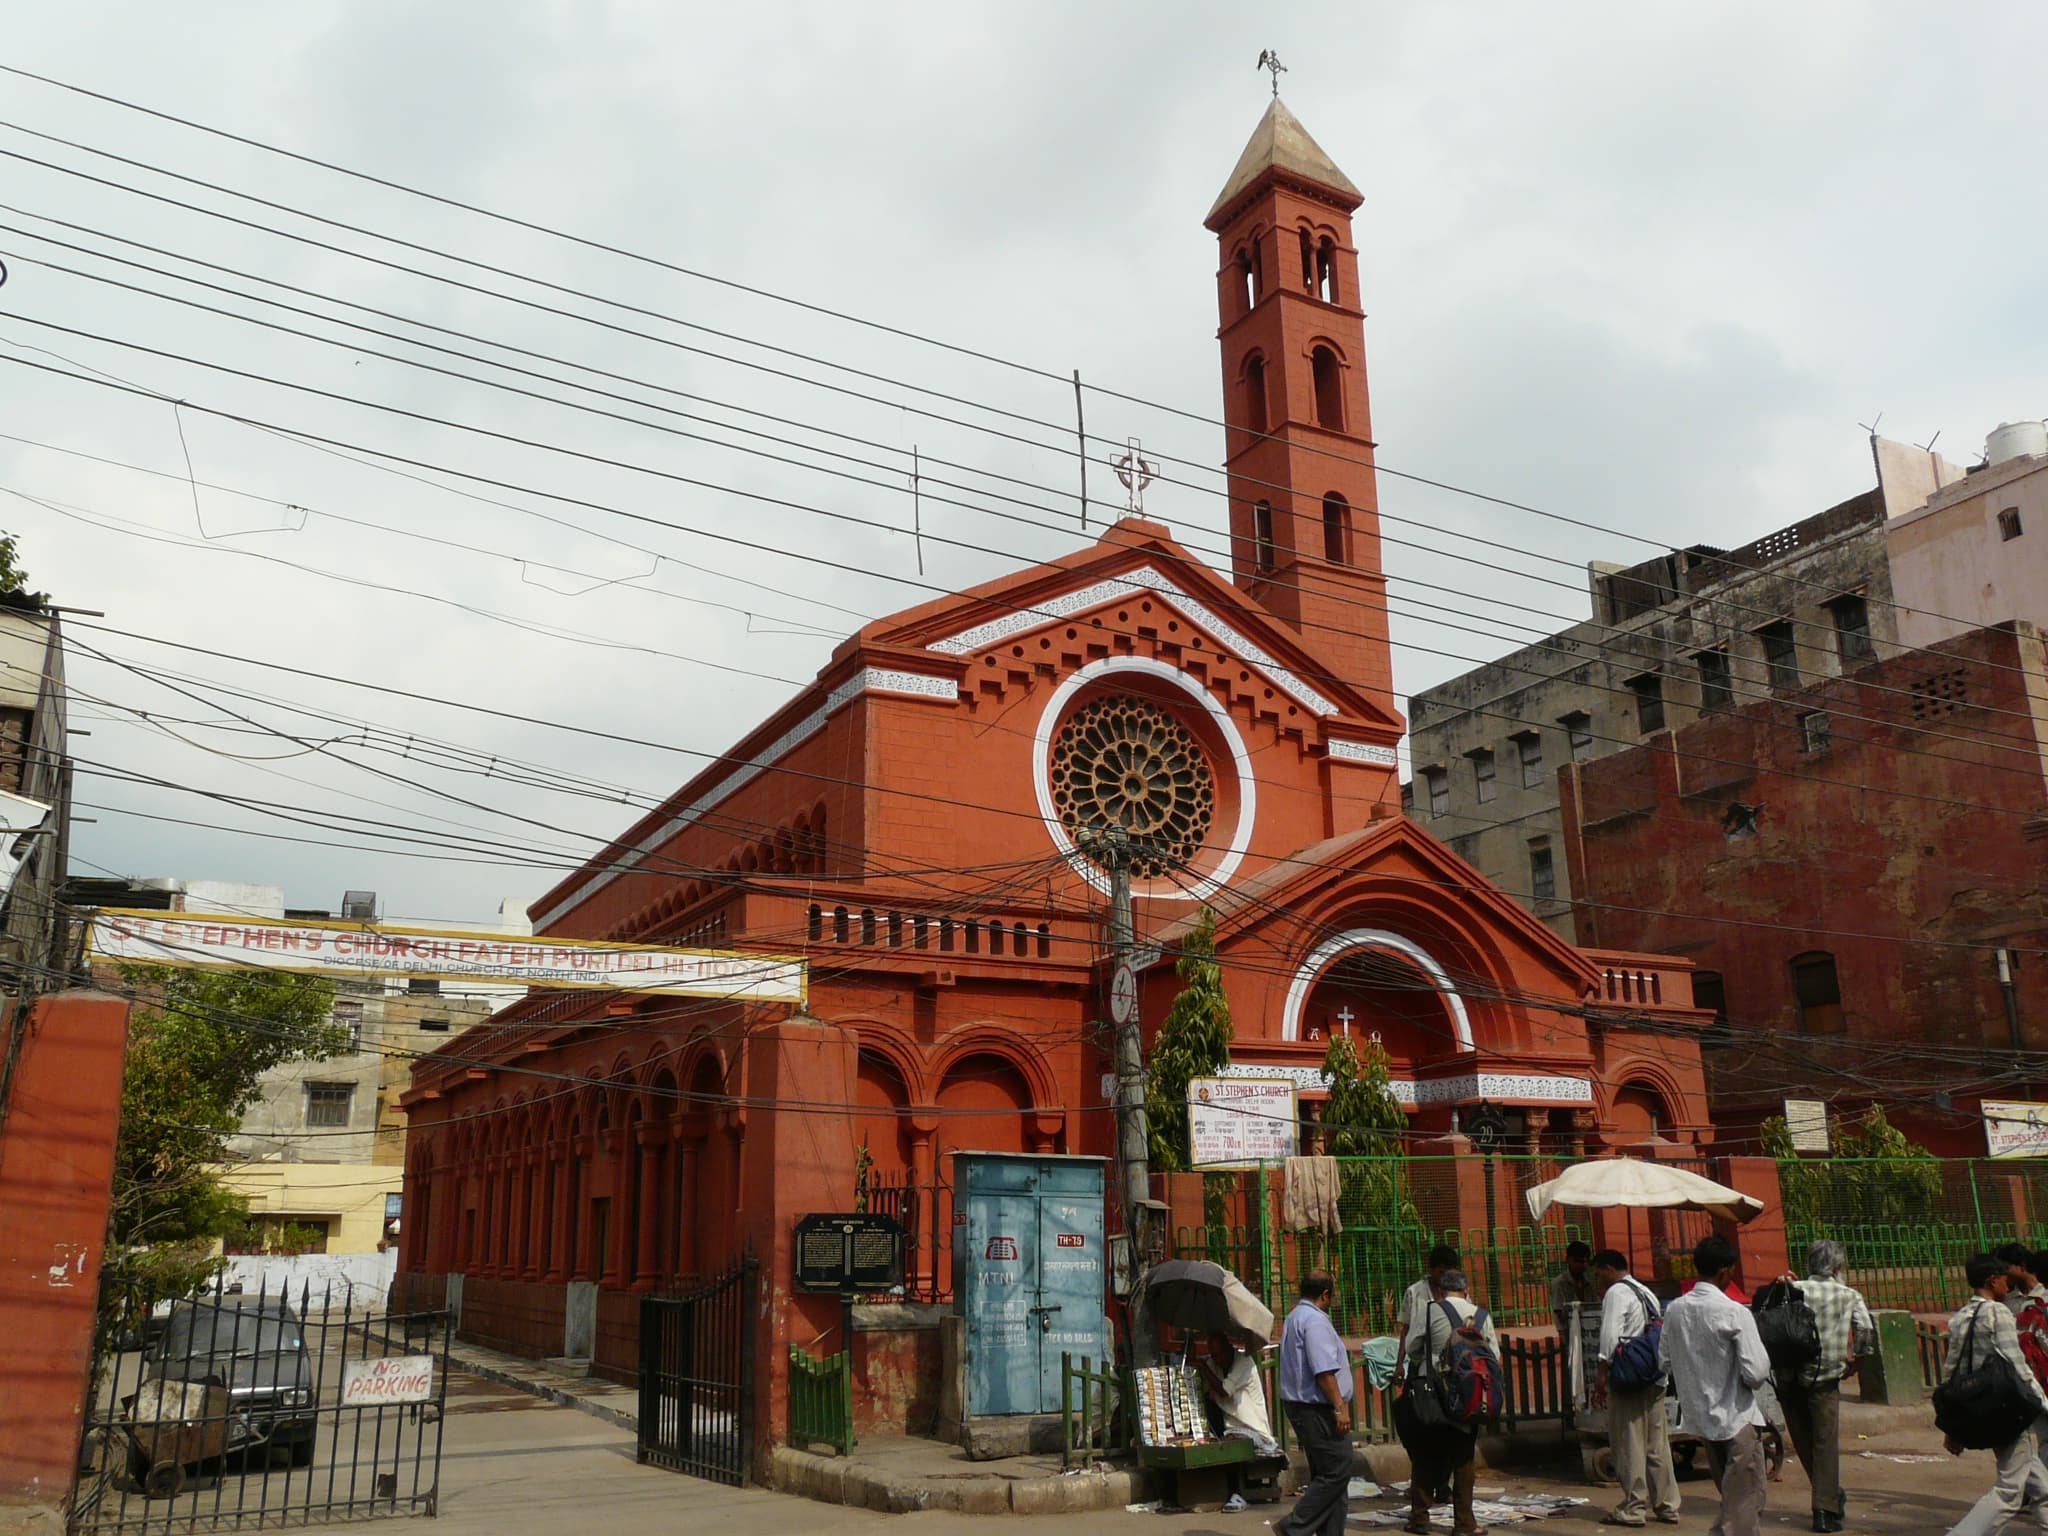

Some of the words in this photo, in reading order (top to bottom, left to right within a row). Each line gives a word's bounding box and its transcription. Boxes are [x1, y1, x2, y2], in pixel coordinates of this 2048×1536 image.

[109, 918, 153, 941] ST
[334, 933, 451, 960] CHURCH
[459, 942, 544, 966] FATEH
[324, 956, 380, 967] DIOCESE
[384, 960, 399, 969] OF
[403, 961, 443, 972] DELHI
[446, 963, 501, 975] CHURCH
[507, 967, 523, 977] OF
[527, 968, 570, 981] NORTH
[575, 973, 610, 983] INDIA
[1261, 1086, 1289, 1097] CHURCH
[347, 1374, 429, 1398] PARKING
